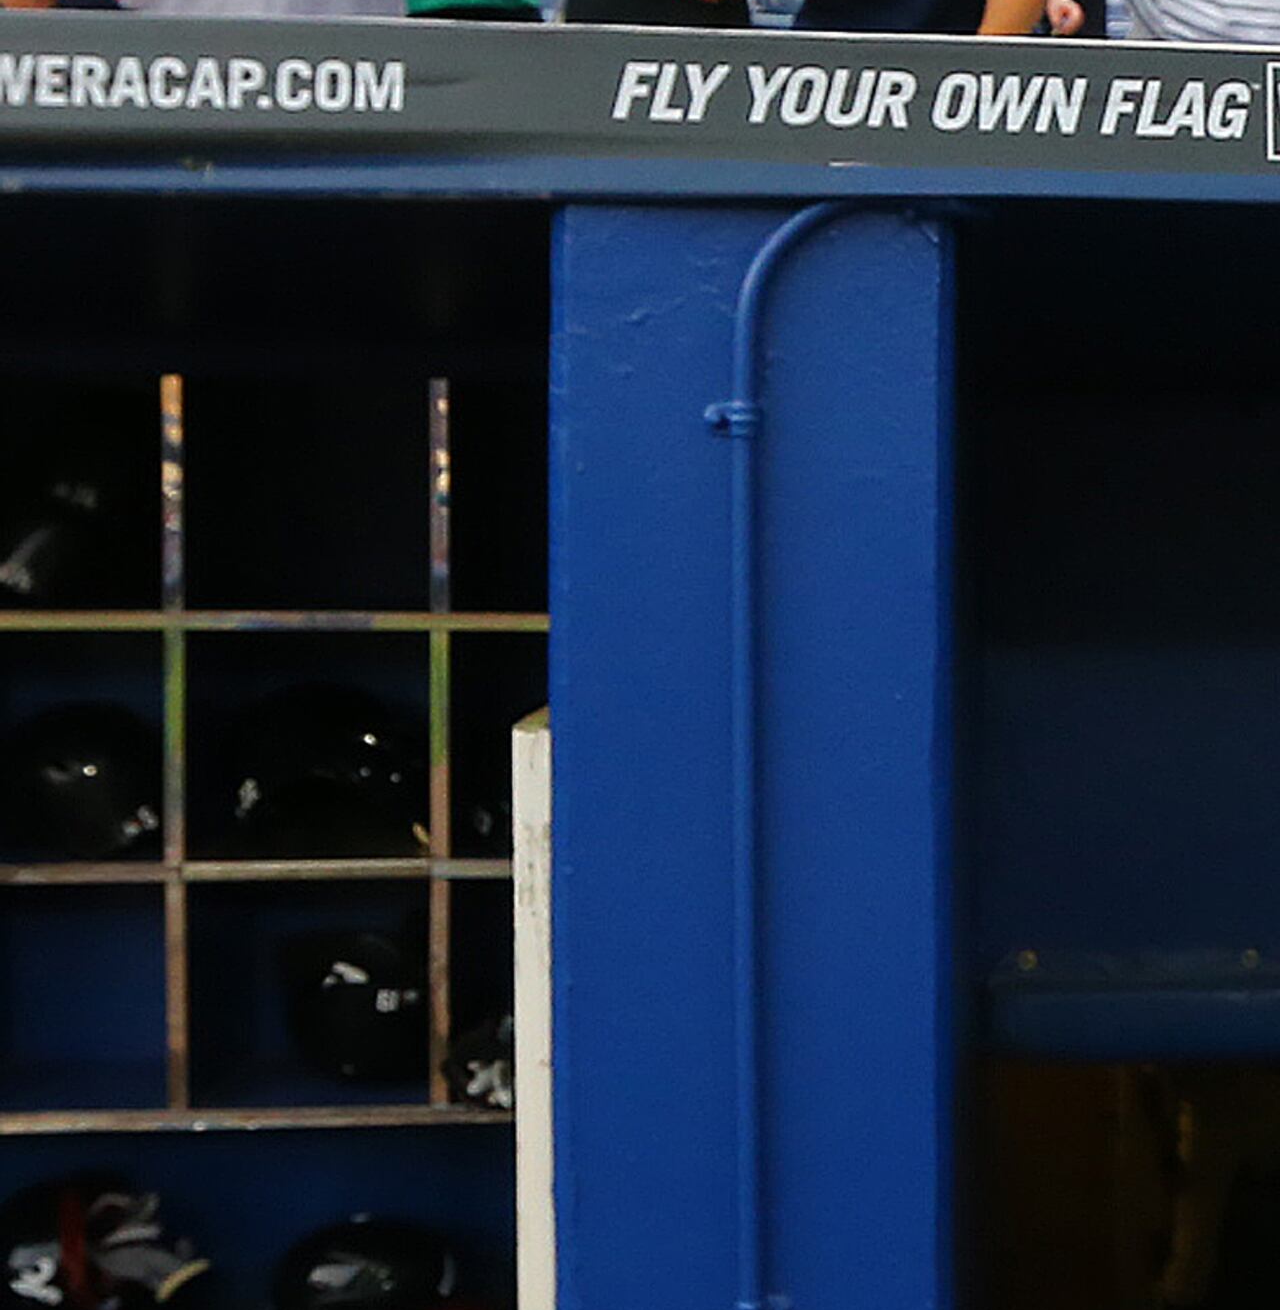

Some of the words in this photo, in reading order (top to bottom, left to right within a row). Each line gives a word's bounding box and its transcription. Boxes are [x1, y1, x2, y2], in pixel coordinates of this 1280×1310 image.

[612, 61, 731, 124] FLY
[746, 65, 917, 129] YOUR
[931, 72, 1088, 135] OWN
[1100, 79, 1253, 140] FLAG
